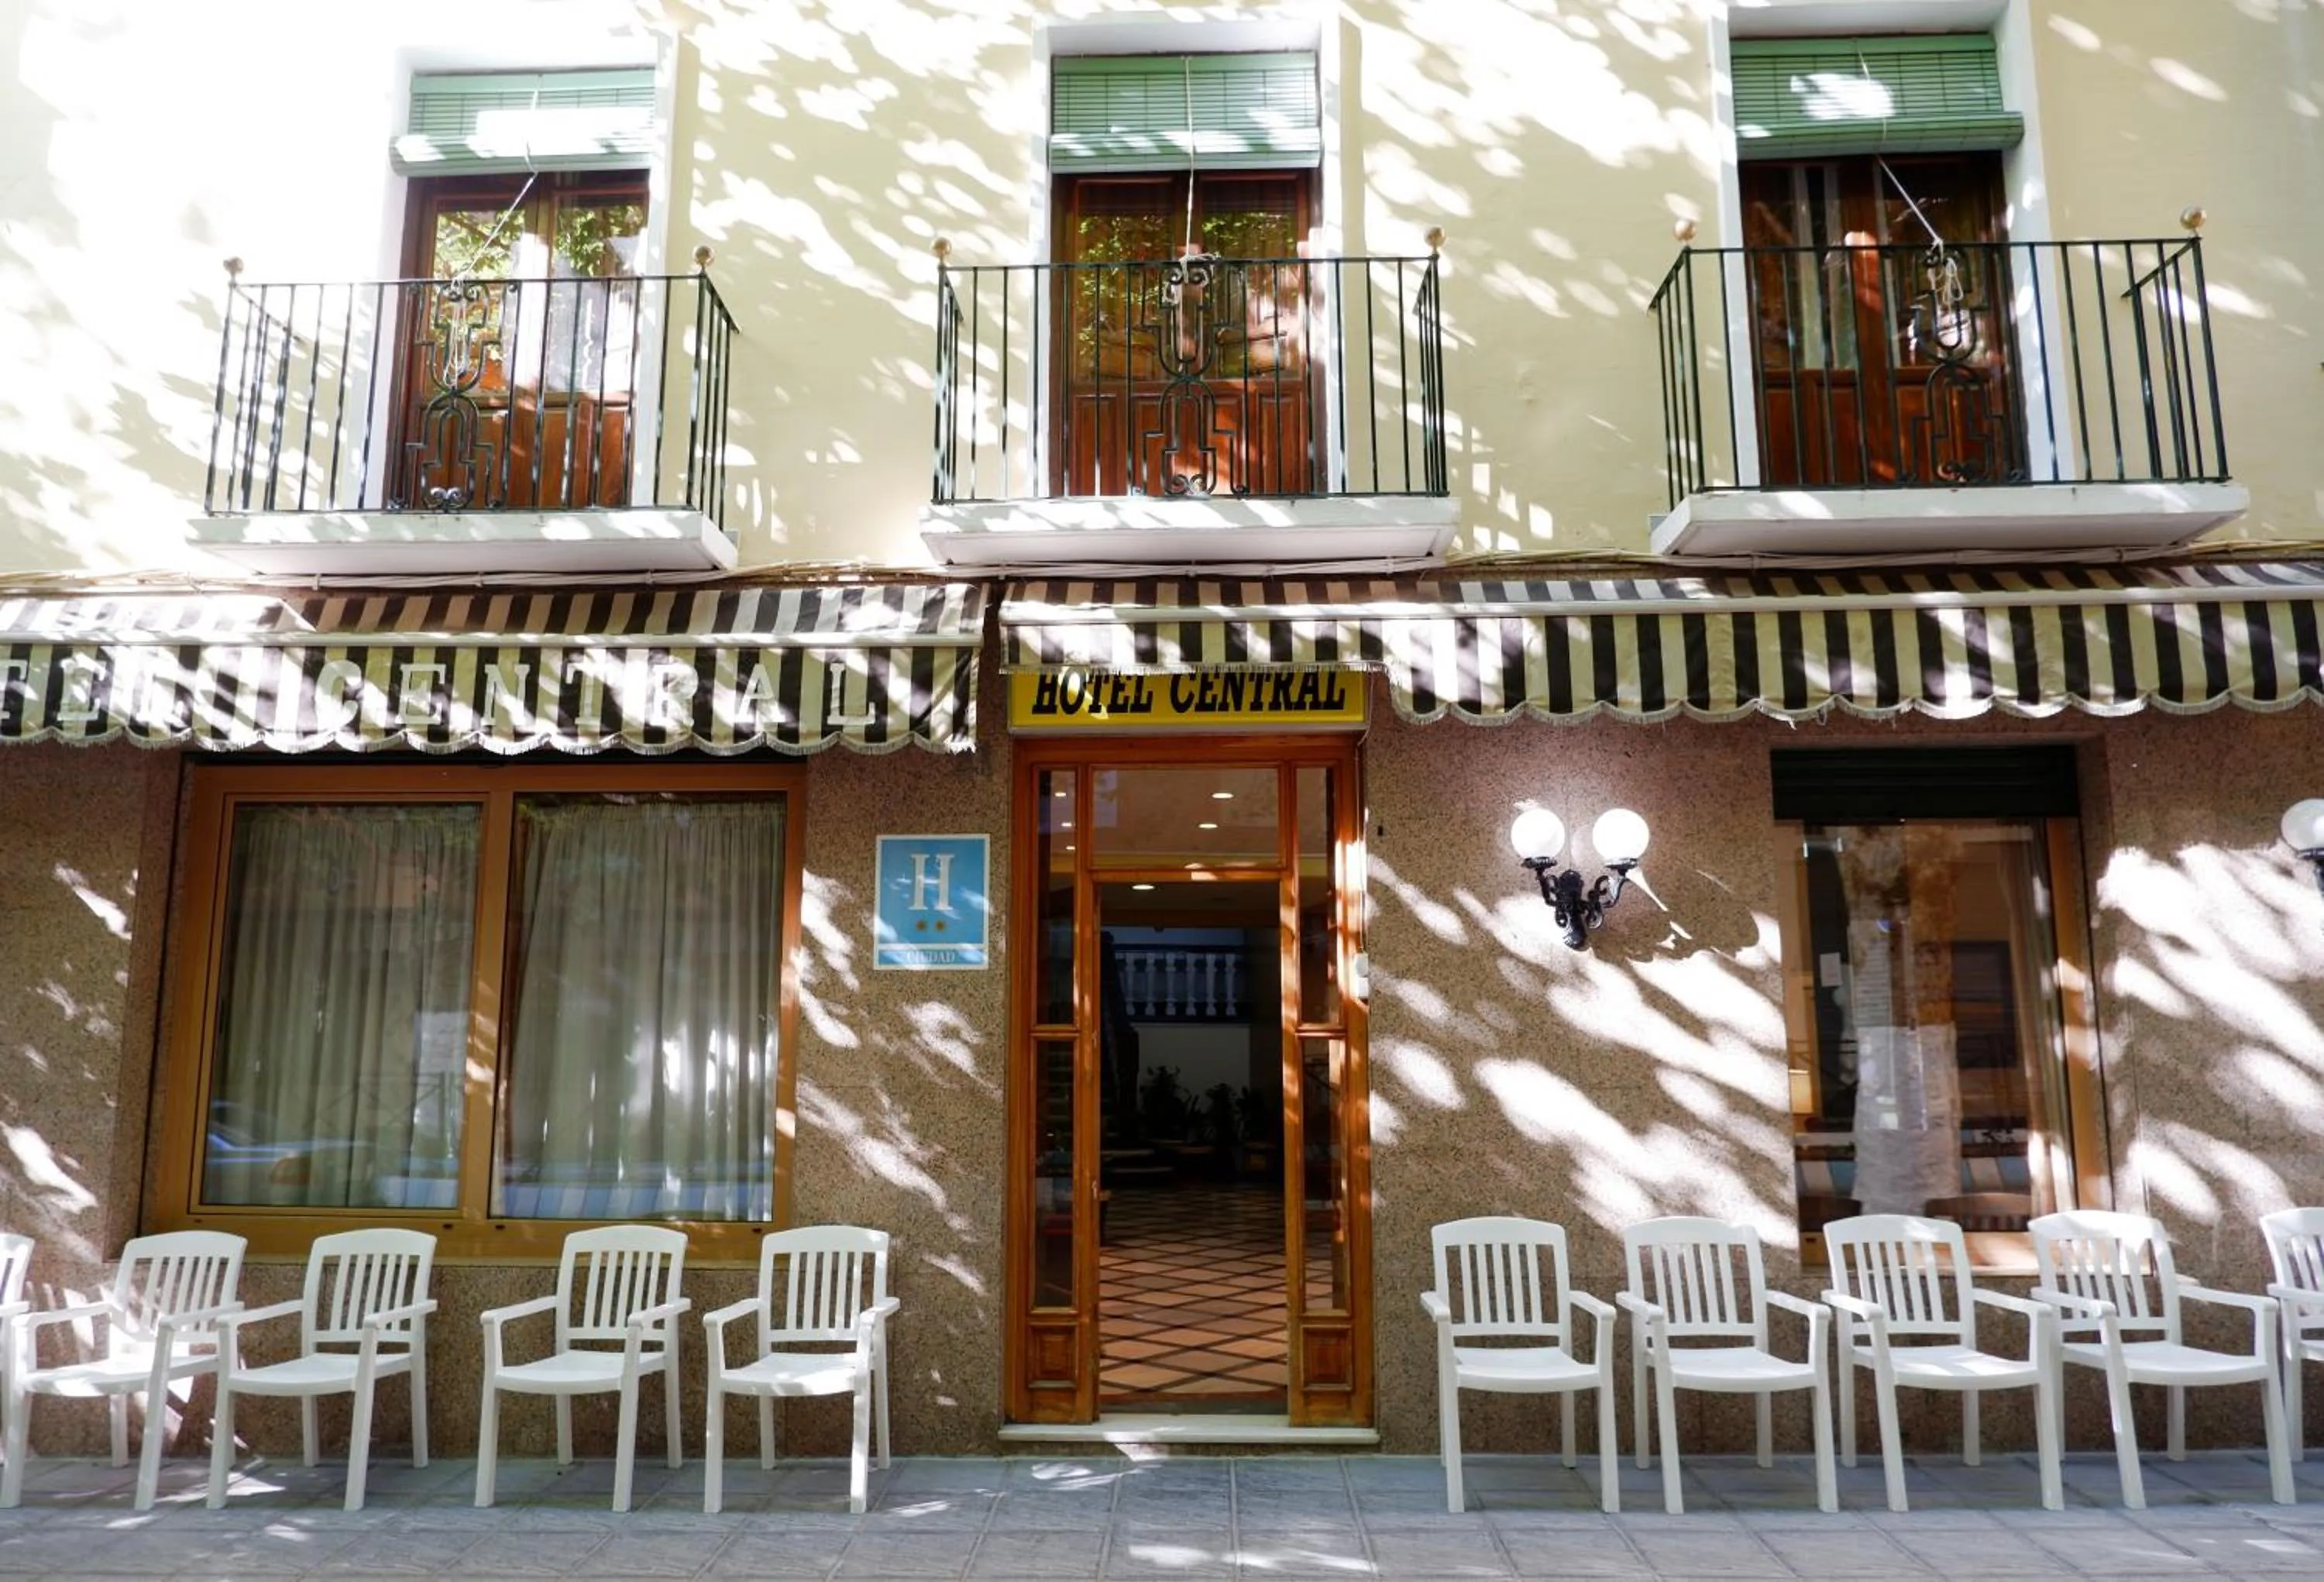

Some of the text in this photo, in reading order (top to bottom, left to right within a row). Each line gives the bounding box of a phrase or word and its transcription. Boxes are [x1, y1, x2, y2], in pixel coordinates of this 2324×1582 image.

[315, 659, 876, 730] CENTRAL
[1031, 666, 1346, 715] HOTEL CENTRAL
[907, 853, 955, 910] H
